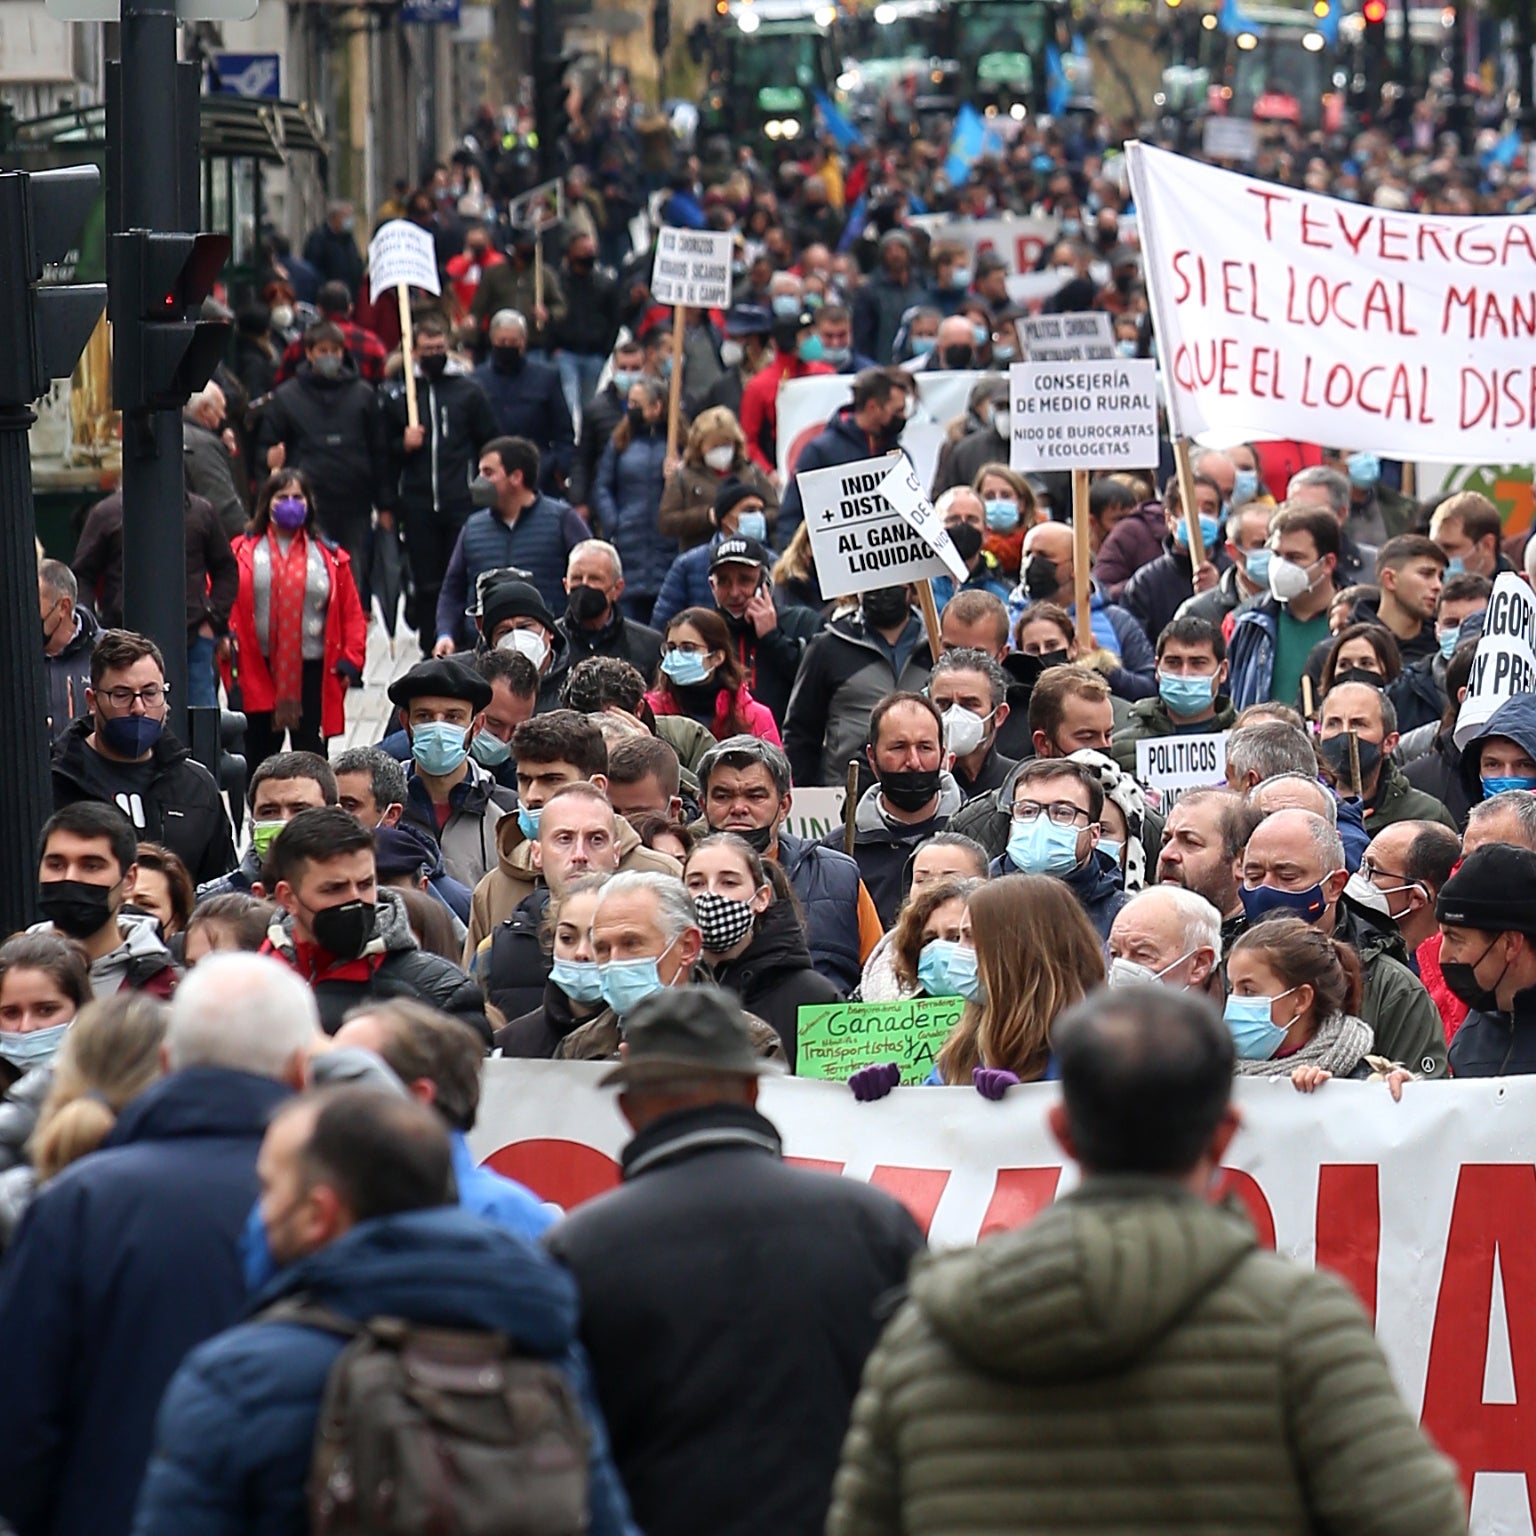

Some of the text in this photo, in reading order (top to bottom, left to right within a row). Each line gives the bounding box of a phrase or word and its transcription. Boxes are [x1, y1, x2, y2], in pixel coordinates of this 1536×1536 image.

[1172, 250, 1207, 307] SI
[1222, 260, 1269, 323] EL
[1286, 265, 1418, 337] LOCAL
[1034, 370, 1130, 393] CONSEJERÍA
[1173, 337, 1239, 395] QUE
[1249, 346, 1286, 400] EL
[1301, 356, 1434, 424] LOCAL
[1016, 394, 1152, 413] DE MEDIO RURAL
[1014, 423, 1155, 441] NIDO DE BUROCRATAS
[1037, 442, 1130, 458] Y ECOLOGETAS
[838, 533, 863, 554] AL
[848, 541, 939, 574] LIQUIDAC
[1149, 741, 1217, 776] POLITICOS
[801, 1036, 904, 1061] Transportistas
